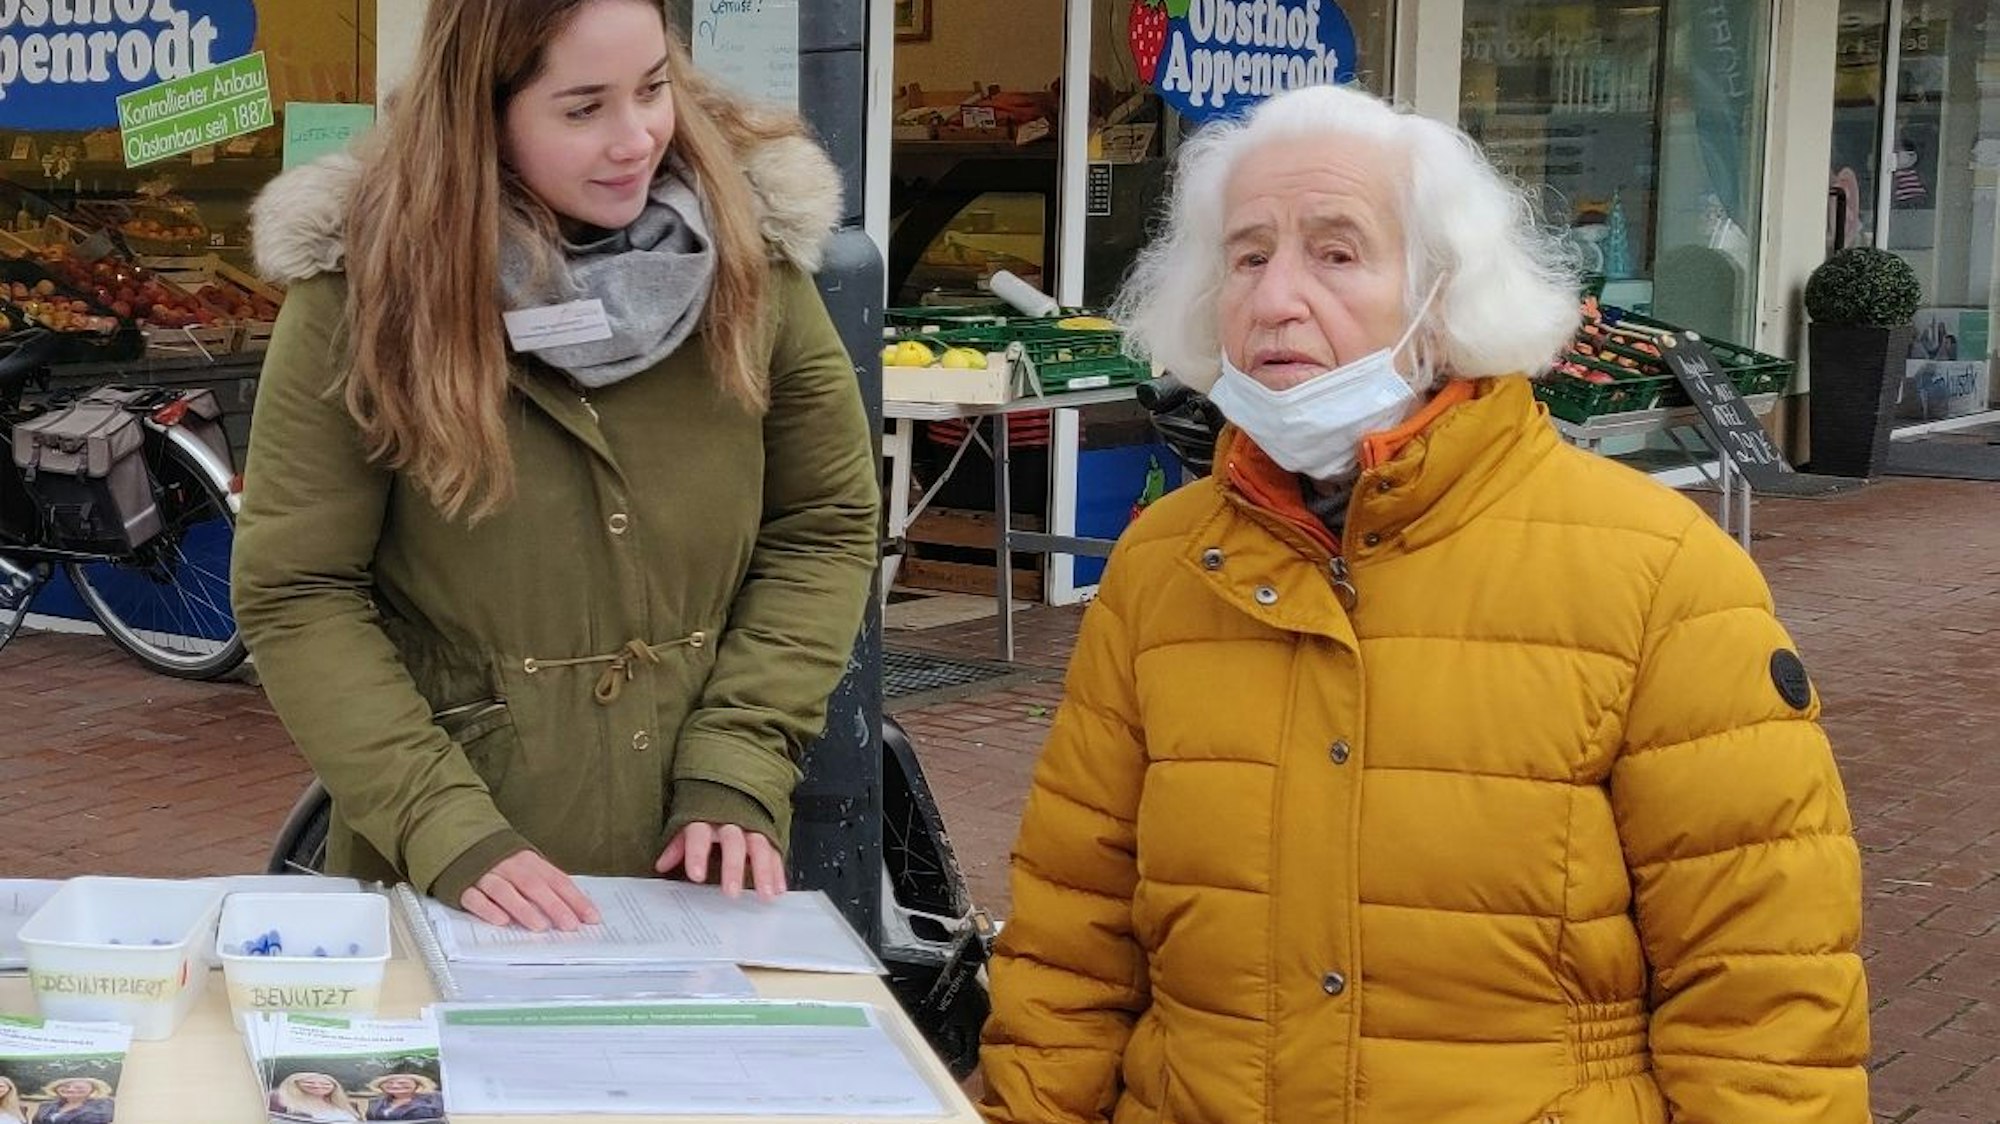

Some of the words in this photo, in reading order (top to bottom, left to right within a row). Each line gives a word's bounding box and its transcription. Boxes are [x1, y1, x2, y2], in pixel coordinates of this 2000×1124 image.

[1189, 0, 1321, 49] Obsthof
[1162, 31, 1339, 108] Appenrodt
[122, 86, 208, 127] Kontrollierter
[212, 67, 262, 99] Anbau
[128, 123, 202, 161] Obstanbau
[205, 112, 228, 139] seit
[232, 98, 267, 130] 1887
[40, 974, 168, 996] DESINFIZIERT
[252, 986, 357, 1008] BENUTZT
